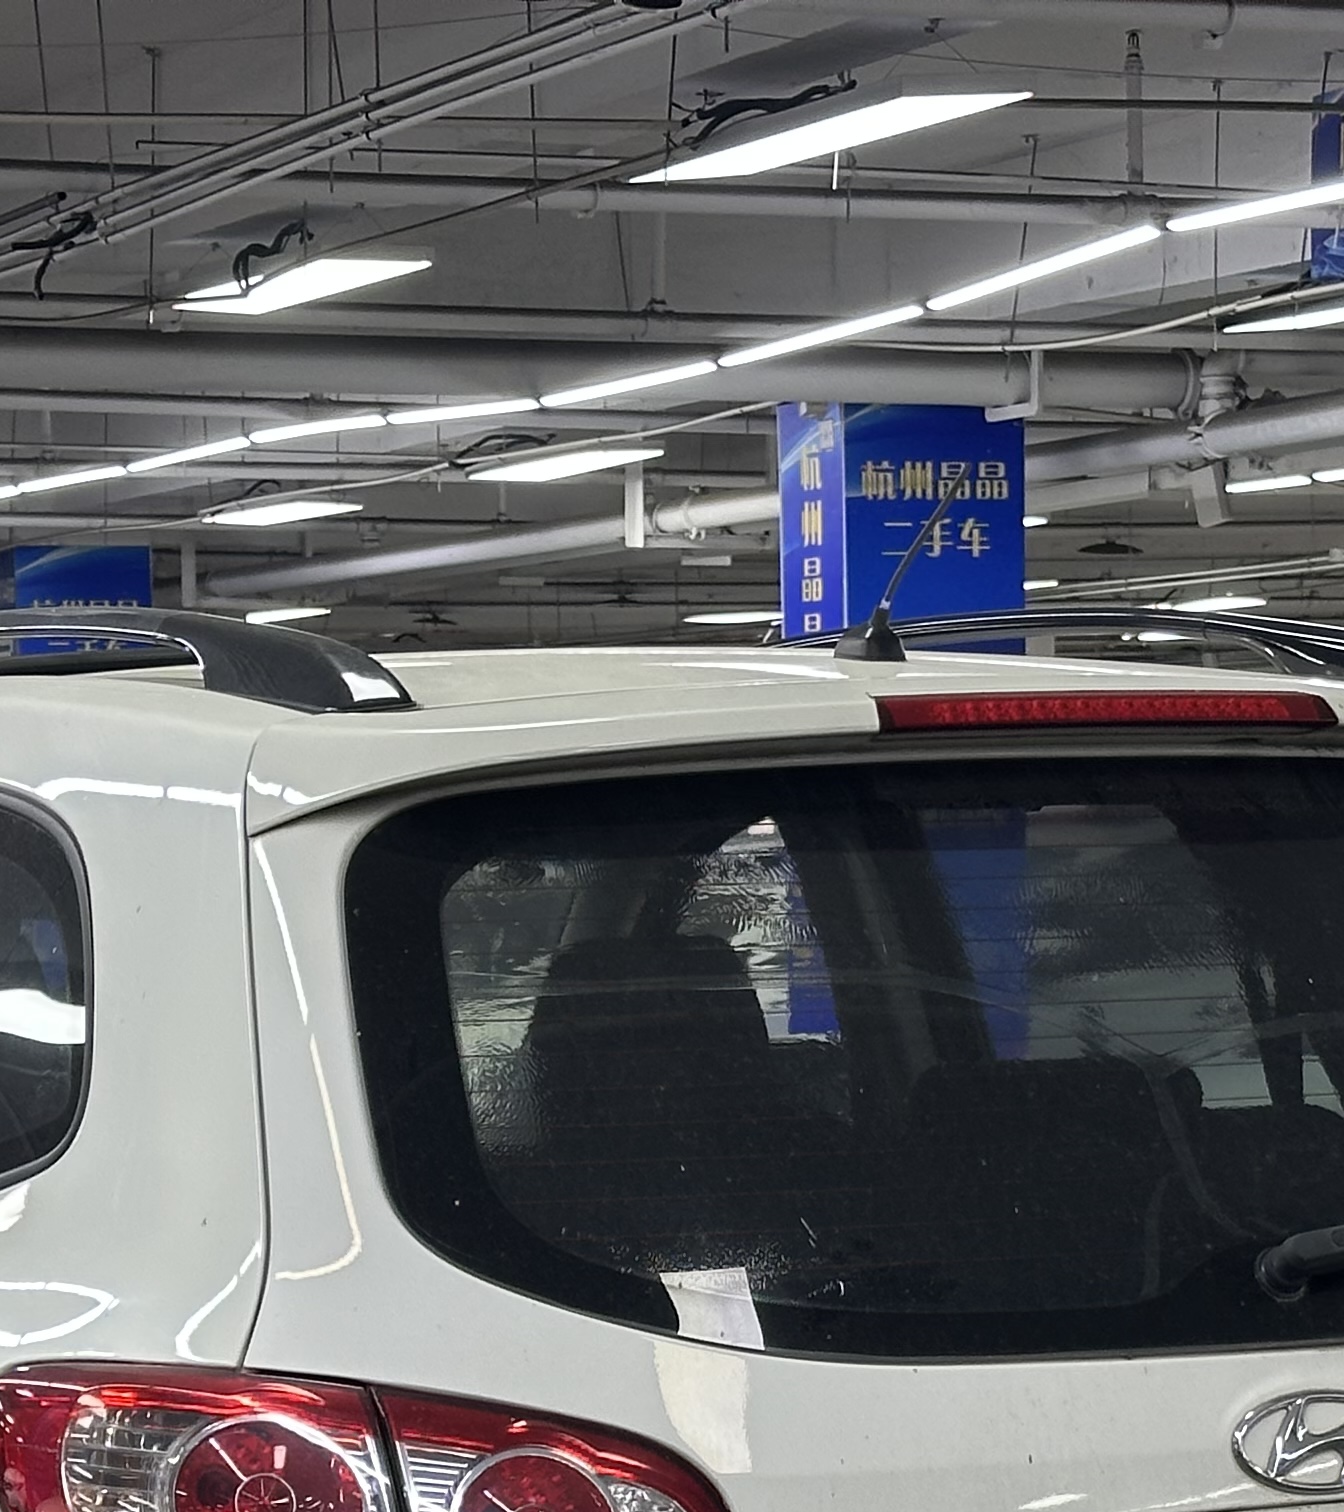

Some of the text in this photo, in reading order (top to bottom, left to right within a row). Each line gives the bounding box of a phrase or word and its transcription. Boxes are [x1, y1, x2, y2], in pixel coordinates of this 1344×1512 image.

[861, 461, 1009, 500] 杭州晶晶
[881, 517, 991, 558] 二手车
